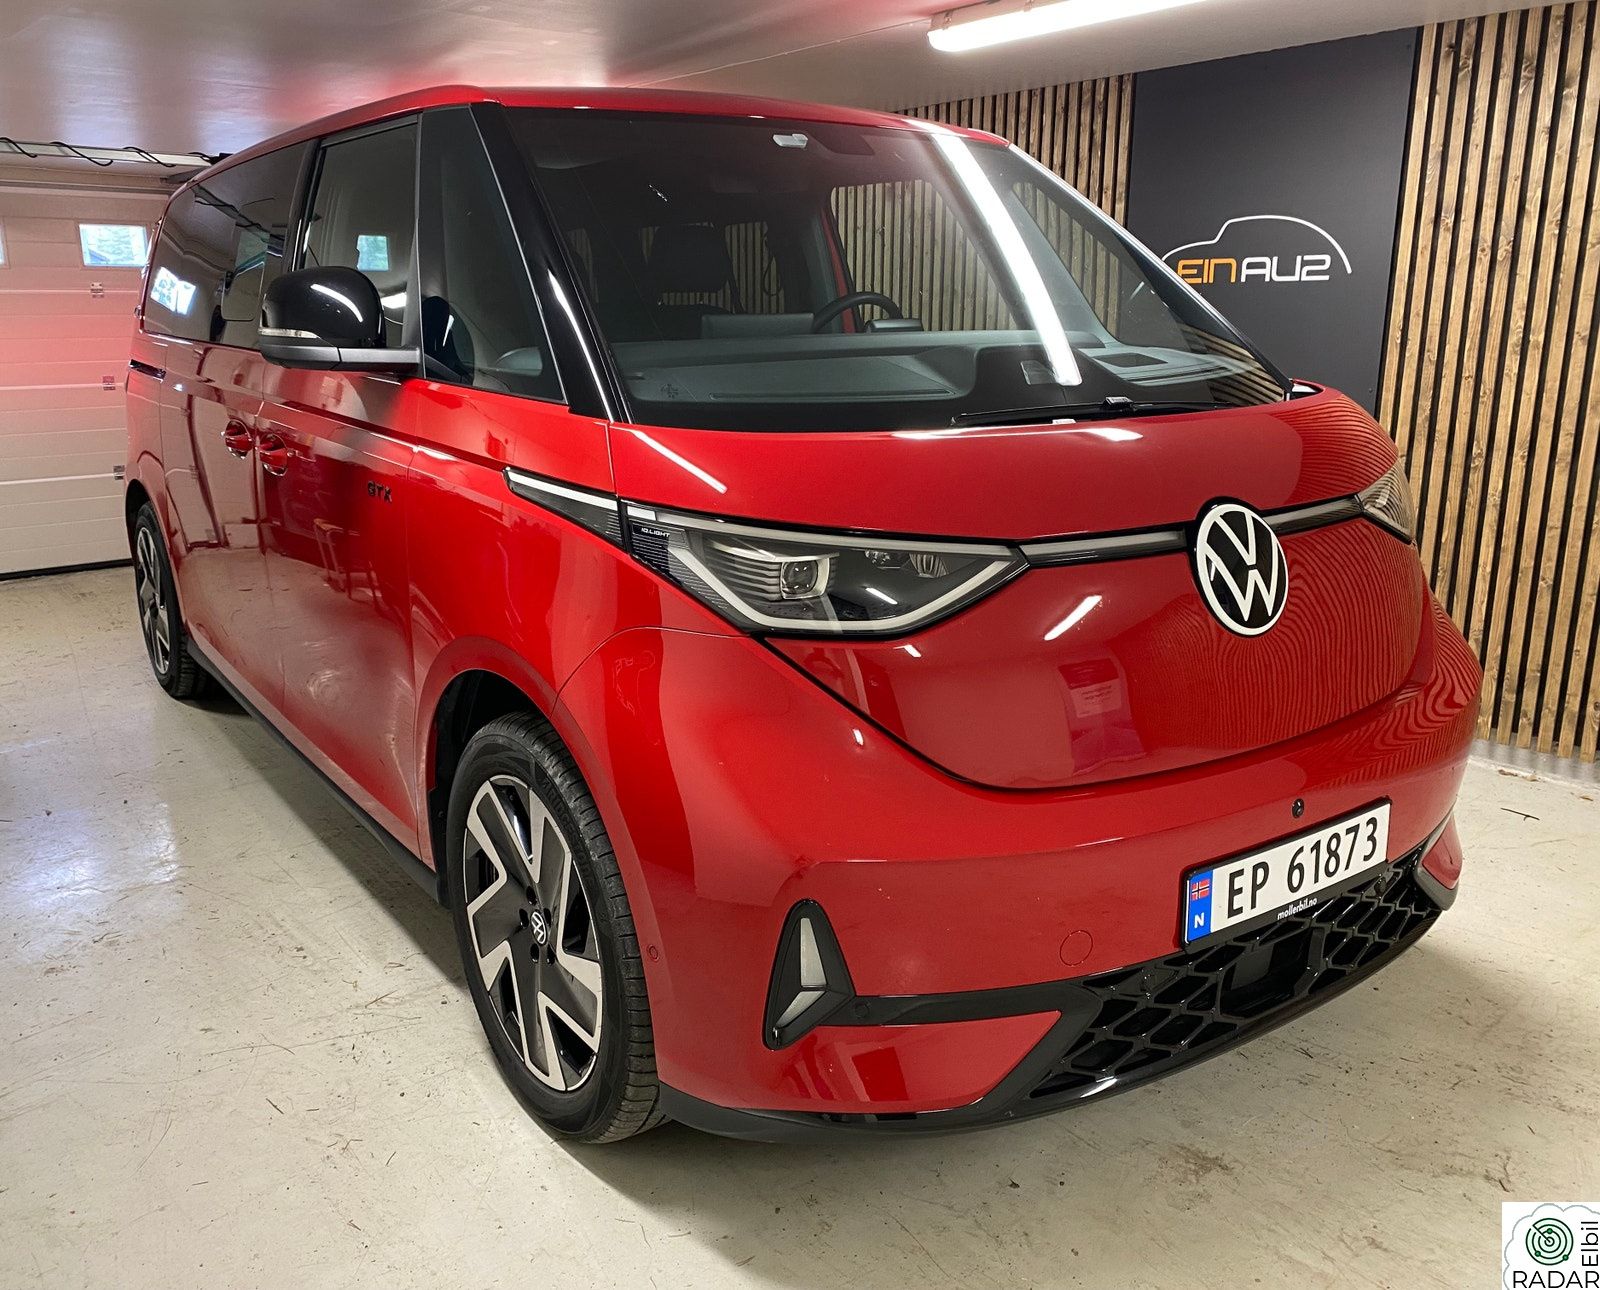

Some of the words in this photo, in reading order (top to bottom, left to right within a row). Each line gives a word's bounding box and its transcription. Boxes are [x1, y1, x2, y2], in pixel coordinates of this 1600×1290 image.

[367, 480, 393, 504] GTX
[1202, 508, 1281, 625] VW
[1227, 861, 1270, 919] EP
[1287, 816, 1378, 894] 61873
[1194, 912, 1205, 929] N
[1277, 897, 1318, 921] mollerbil.no
